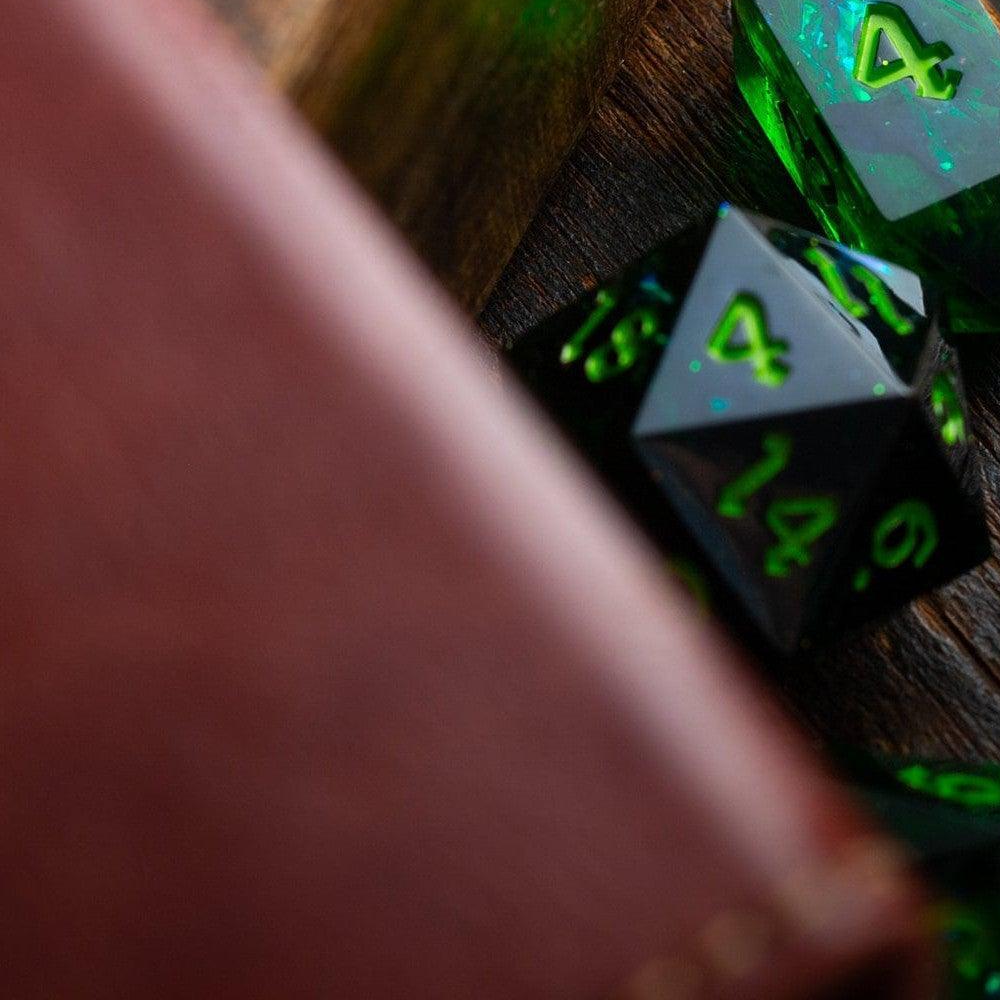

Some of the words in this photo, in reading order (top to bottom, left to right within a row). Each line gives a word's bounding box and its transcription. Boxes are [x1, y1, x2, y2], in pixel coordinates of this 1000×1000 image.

[852, 0, 963, 100] 4
[706, 293, 790, 387] 4
[717, 432, 838, 577] 14
